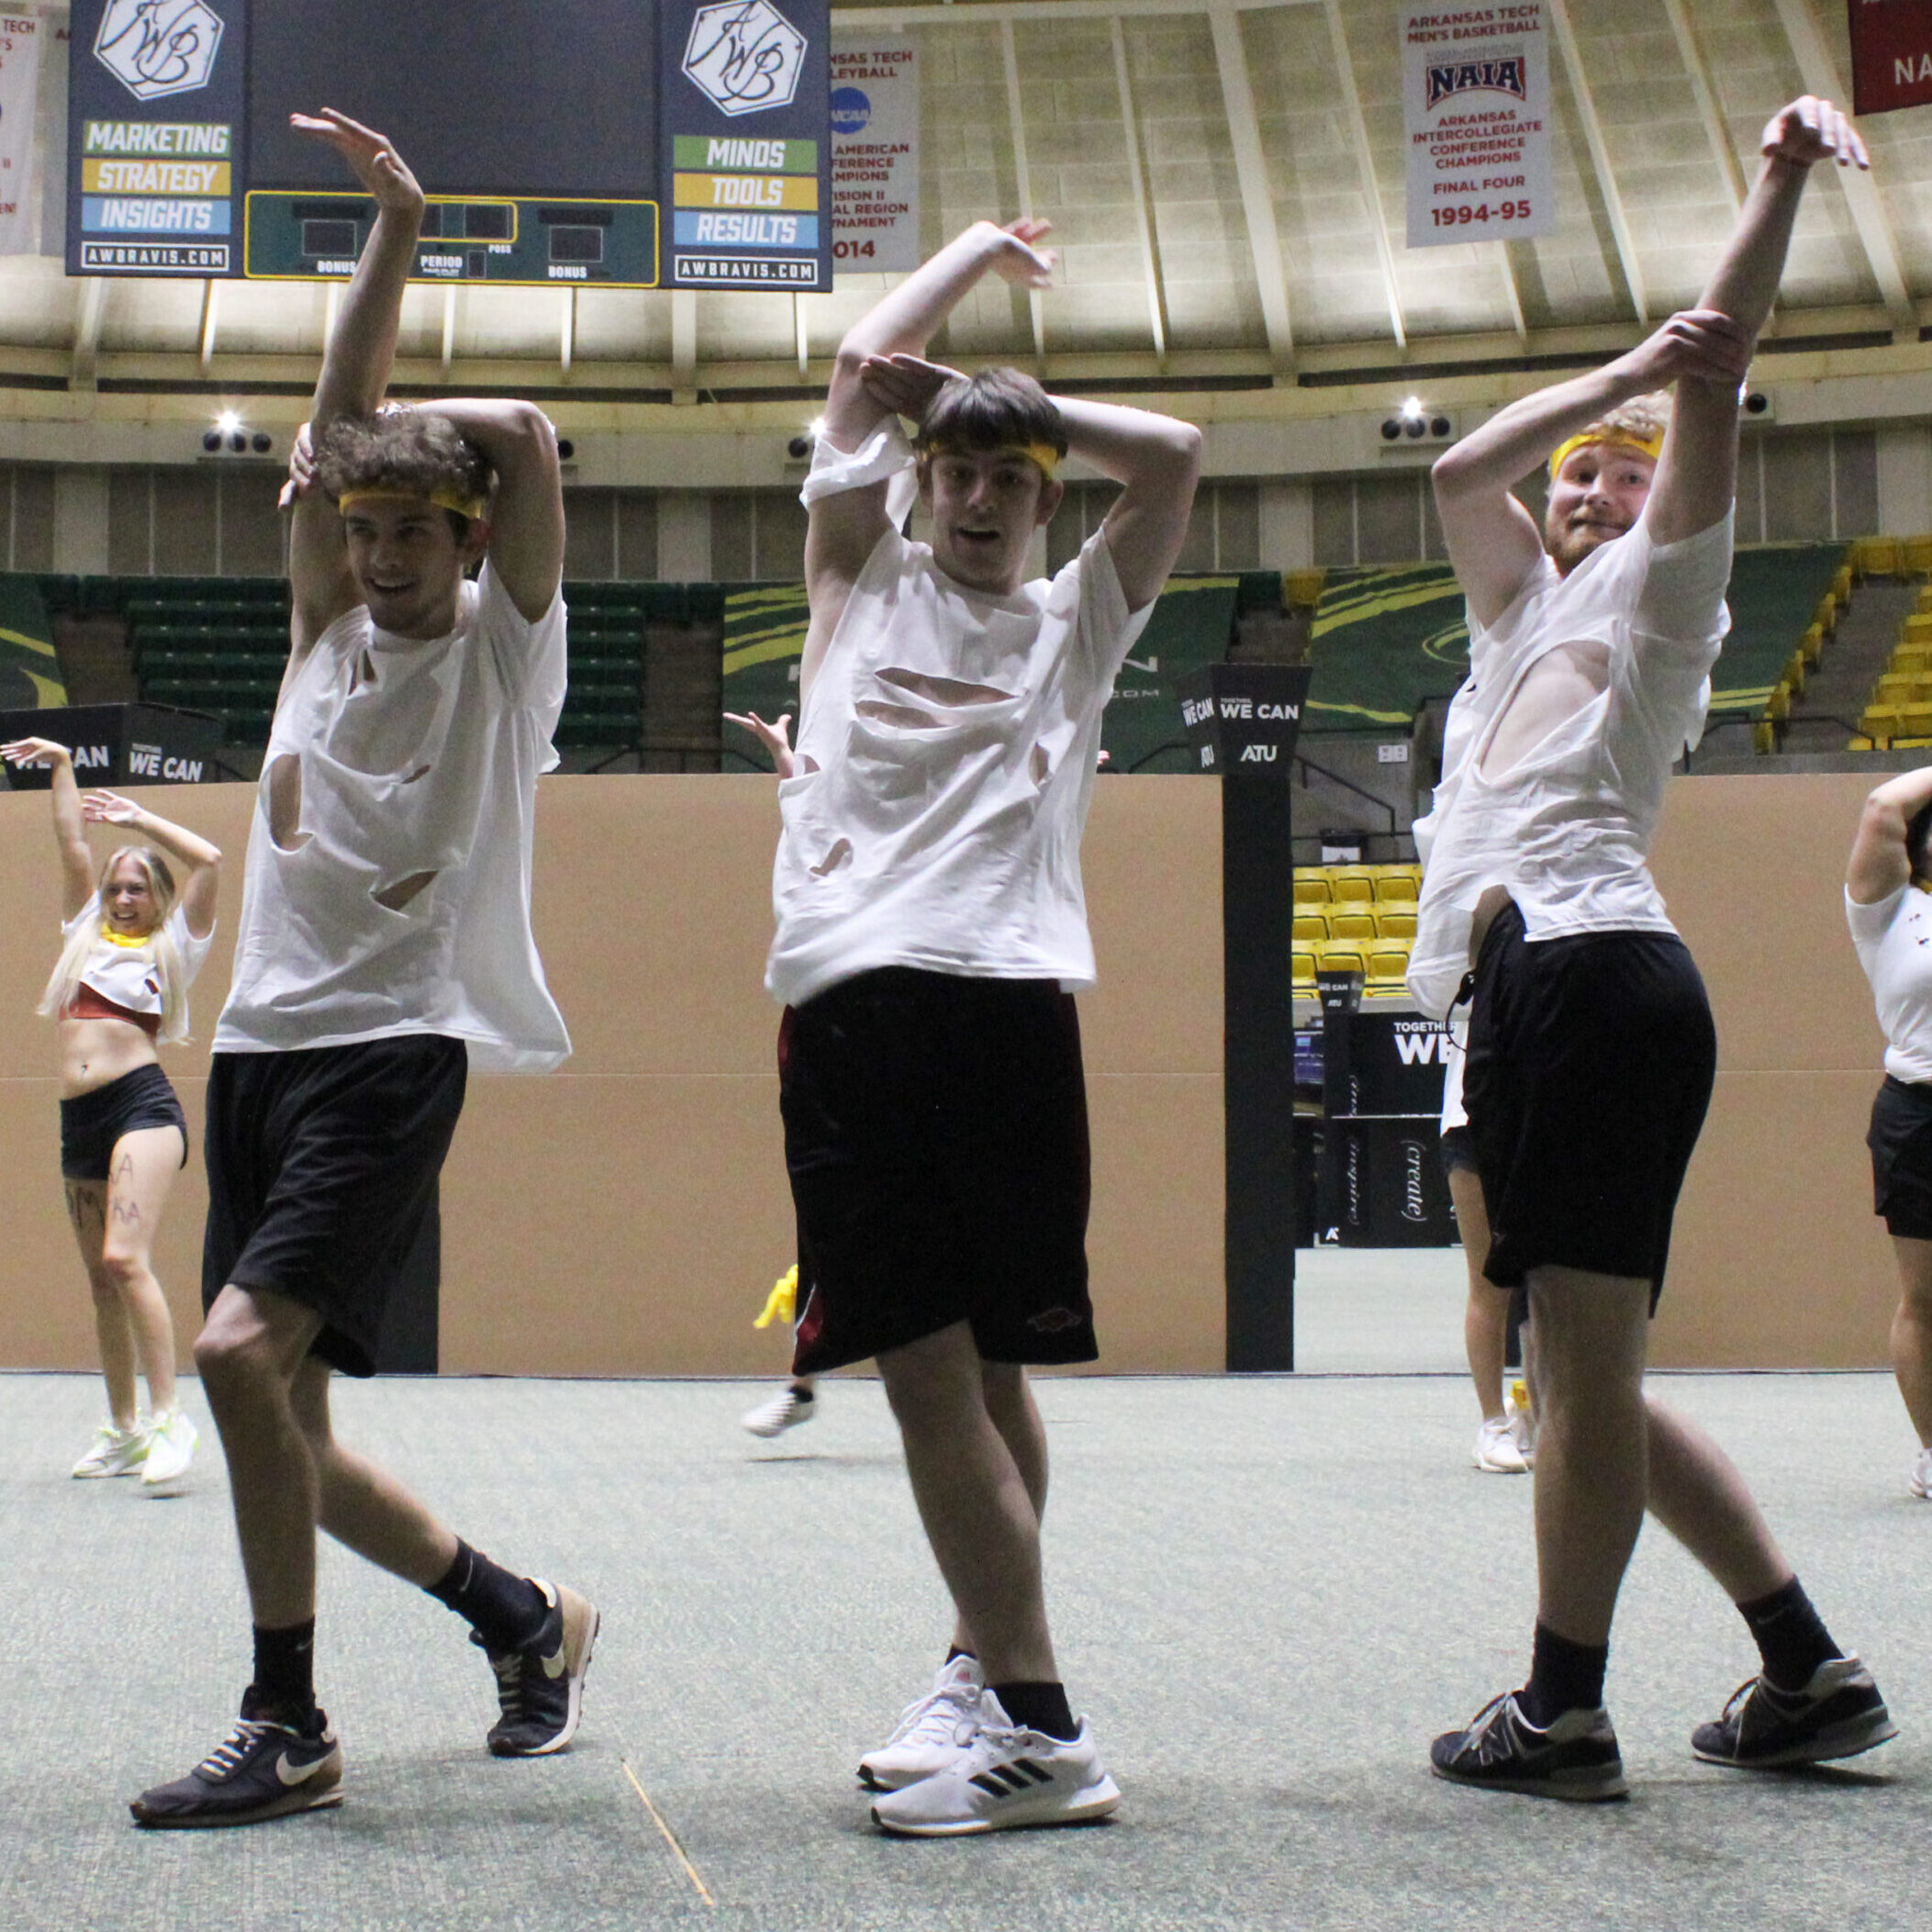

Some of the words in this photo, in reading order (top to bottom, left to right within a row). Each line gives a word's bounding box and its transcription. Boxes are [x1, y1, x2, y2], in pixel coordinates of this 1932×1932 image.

[4, 19, 35, 33] TECH
[1408, 9, 1494, 28] ARKANSAS
[1498, 5, 1540, 19] TECH
[1408, 28, 1449, 43] MEN'S
[1453, 19, 1540, 39] BASKETBALL
[873, 51, 913, 63] TECH
[1429, 60, 1524, 102] NAIA
[1438, 110, 1517, 128] ARKANSAS
[87, 123, 229, 153] MARKETING
[1413, 120, 1542, 143] INTERCOLLEGIATE
[707, 140, 787, 169] MINDS
[835, 143, 910, 155] AMERICAN
[1430, 137, 1525, 156] CONFERENCE
[1435, 151, 1522, 169] CHAMPIONS
[97, 162, 218, 192] STRATEGY
[1434, 181, 1479, 195] FINAL
[1483, 175, 1525, 190] FOUR
[712, 177, 784, 207] TOOLS
[876, 190, 885, 200] II
[101, 199, 212, 229] INSIGHTS
[854, 203, 909, 215] REGION
[1431, 199, 1532, 227] 1994-95
[697, 213, 798, 244] RESULTS
[88, 249, 223, 265] AWBRAVIS.COM
[420, 255, 463, 268] PERIOD
[318, 261, 356, 274] BONUS
[548, 265, 587, 278] BONUS
[682, 262, 812, 279] AWBRAVIS.COM
[1182, 705, 1198, 727] WE
[1197, 698, 1215, 720] CAN
[1221, 704, 1253, 719] WE
[1257, 705, 1299, 720] CAN
[67, 745, 110, 768] AN
[1240, 744, 1278, 763] ATU
[129, 751, 162, 776] WE
[163, 757, 203, 782] CAN
[1400, 1139, 1427, 1222] (create)
